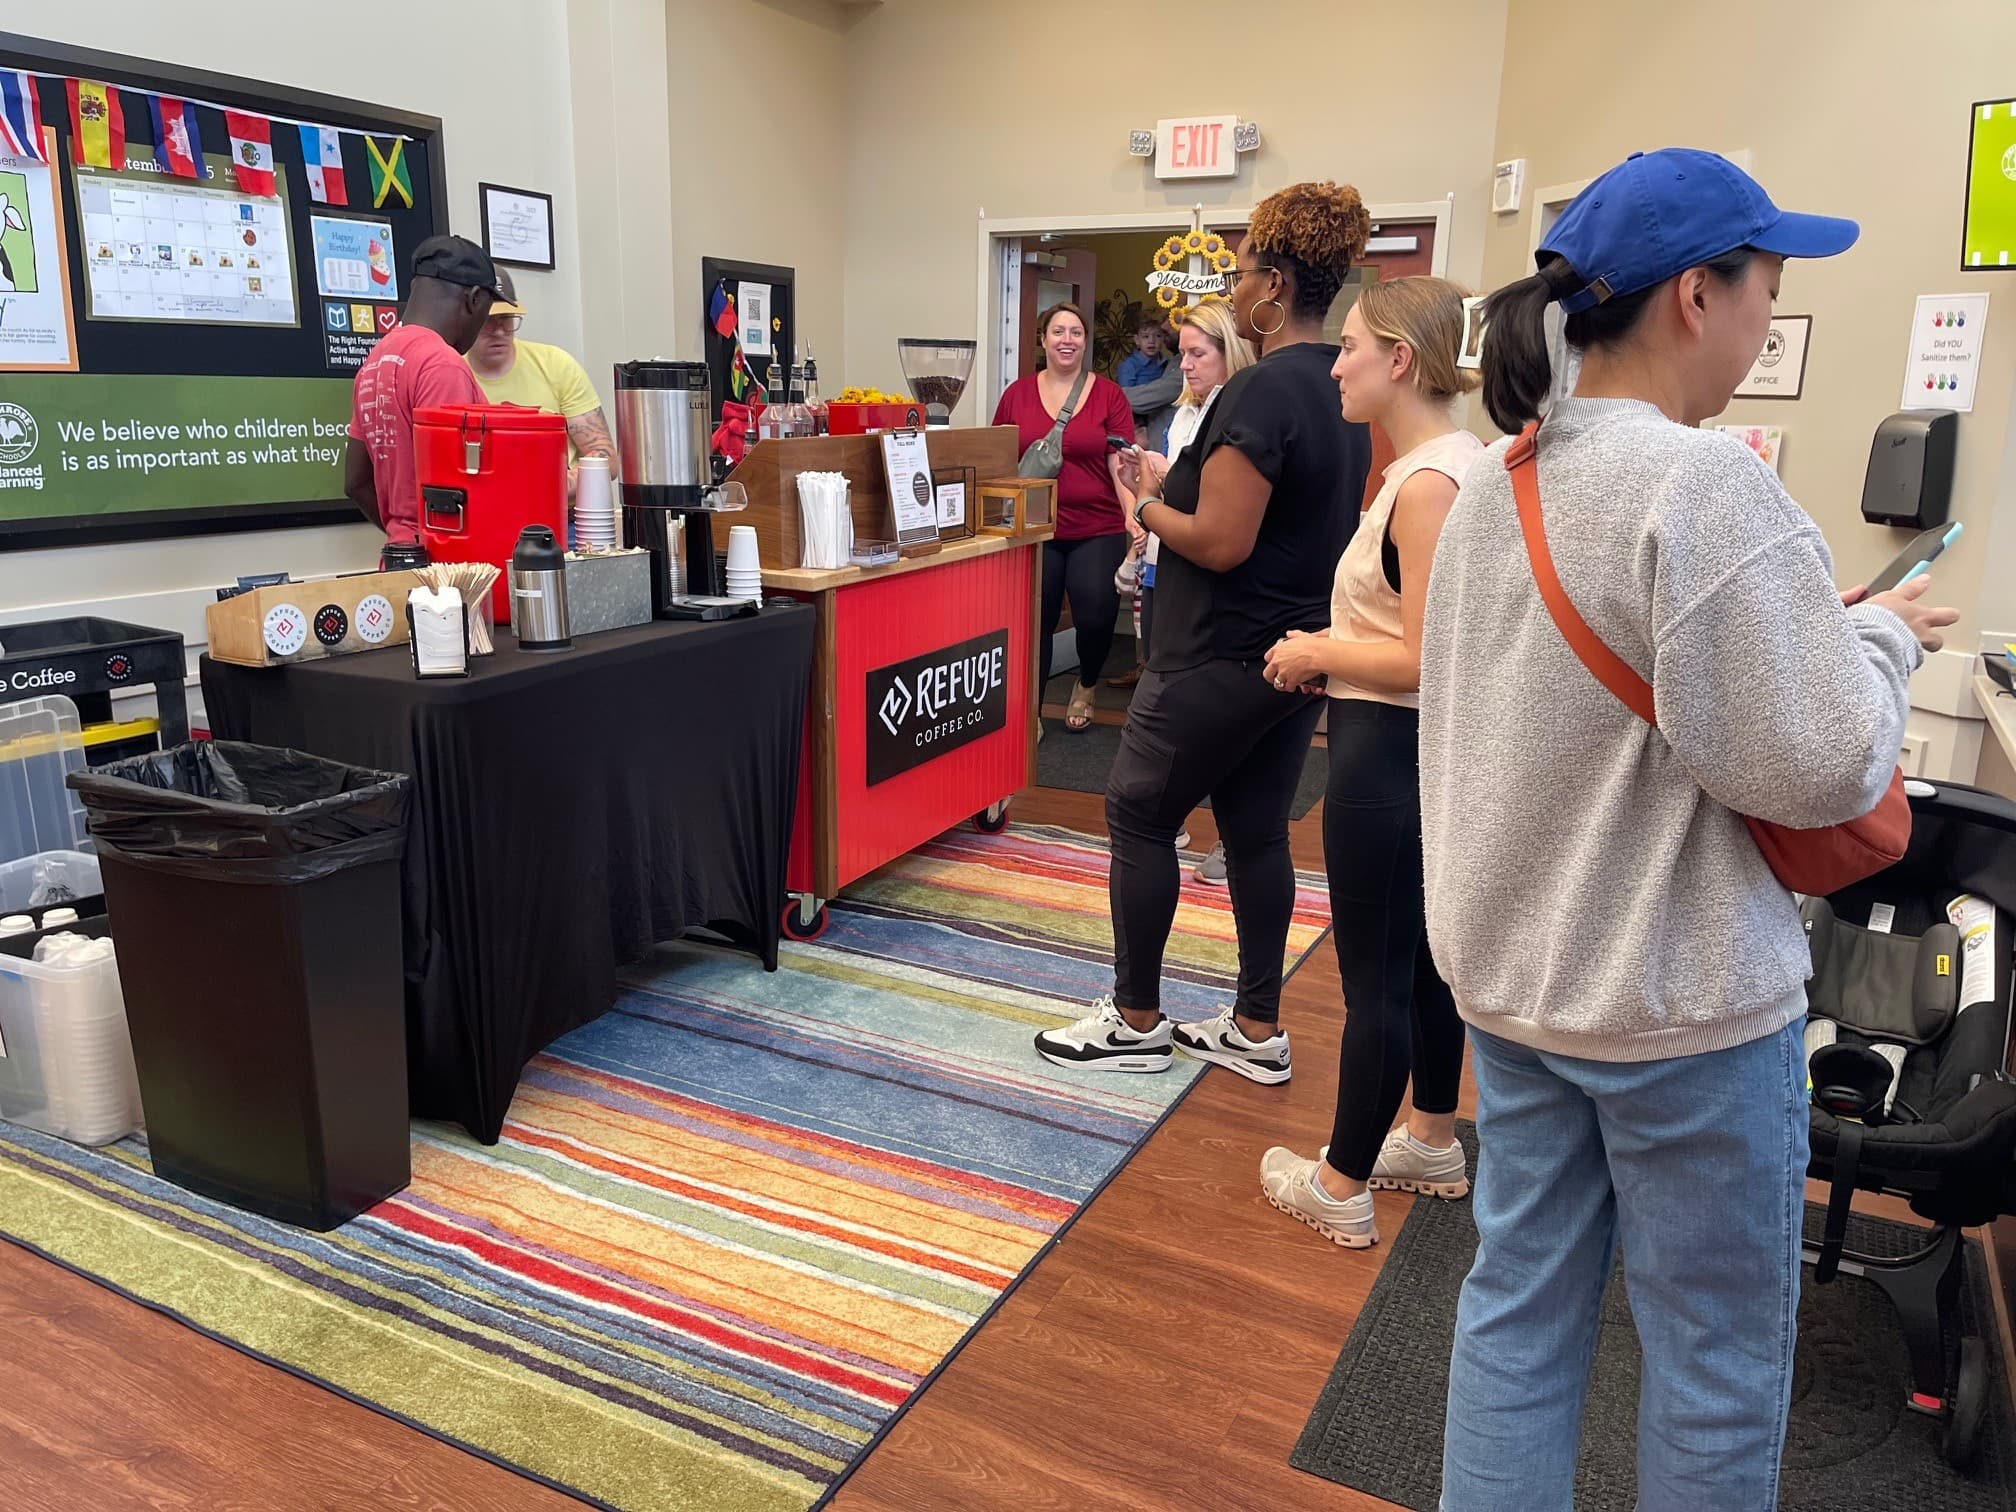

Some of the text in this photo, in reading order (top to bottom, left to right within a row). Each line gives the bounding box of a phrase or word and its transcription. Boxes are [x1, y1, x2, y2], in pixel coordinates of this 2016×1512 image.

[1171, 123, 1223, 169] EXIT
[0, 157, 17, 166] ers
[331, 232, 355, 243] Happy
[328, 242, 360, 255] Birthday!
[328, 335, 340, 344] The
[341, 336, 357, 346] Right
[1934, 339, 1963, 348] Did YOU
[329, 345, 348, 354] Active
[330, 356, 361, 366] and Happy
[1921, 353, 1972, 361] Sanitize them?
[1754, 376, 1780, 384] OFFICE
[57, 417, 350, 442] We believe who children beco
[61, 442, 340, 475] is as important as what they
[0, 464, 42, 477] lanced
[0, 477, 43, 490] arning
[11, 668, 76, 690] Coffee
[915, 709, 984, 747] COFFEE CO.
